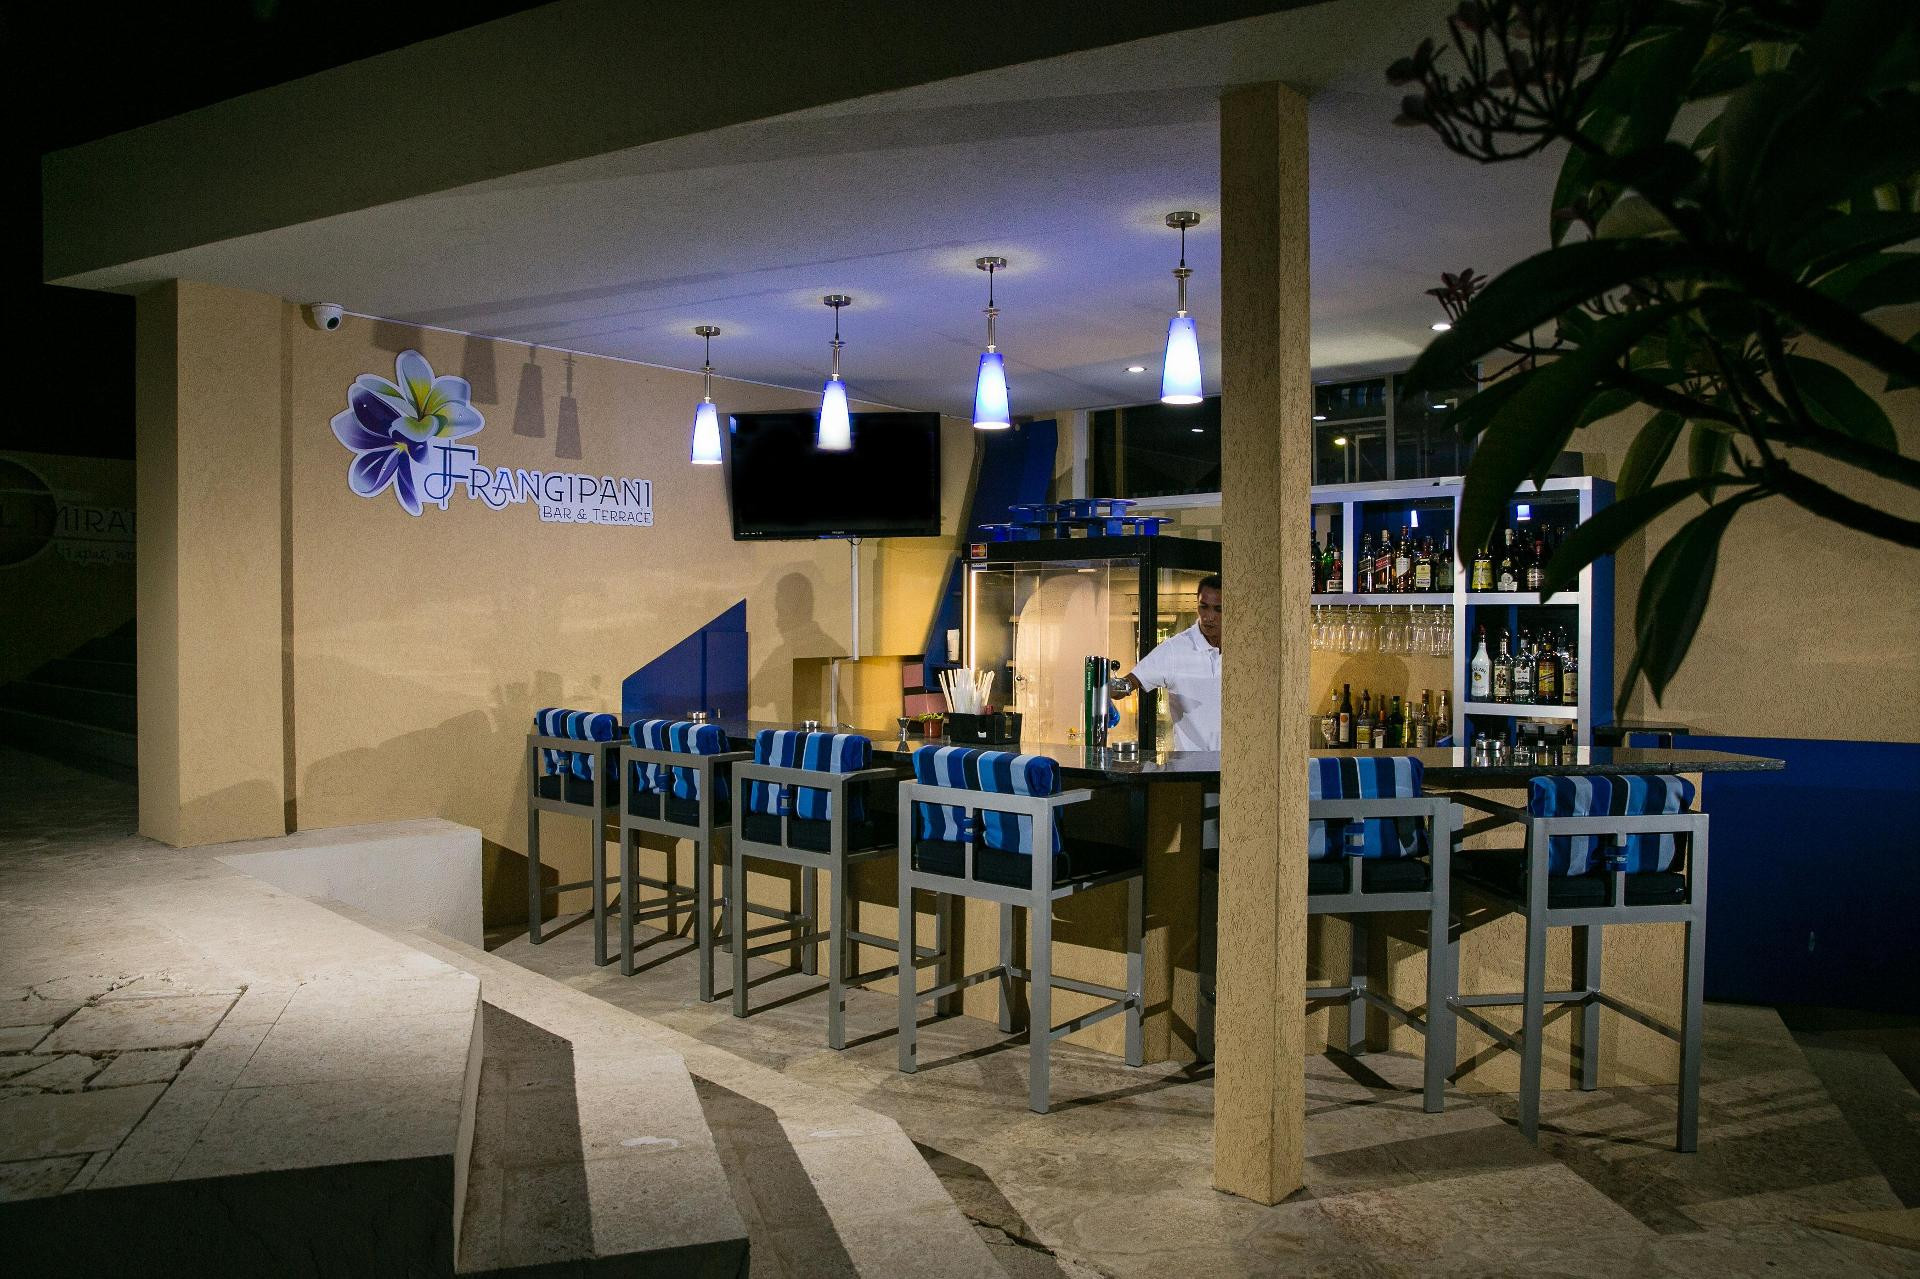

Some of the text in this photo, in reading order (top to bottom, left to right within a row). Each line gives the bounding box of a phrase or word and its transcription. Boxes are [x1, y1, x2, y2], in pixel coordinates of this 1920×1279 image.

[33, 504, 136, 534] MIRA
[542, 505, 651, 524] BAR & TERRACE
